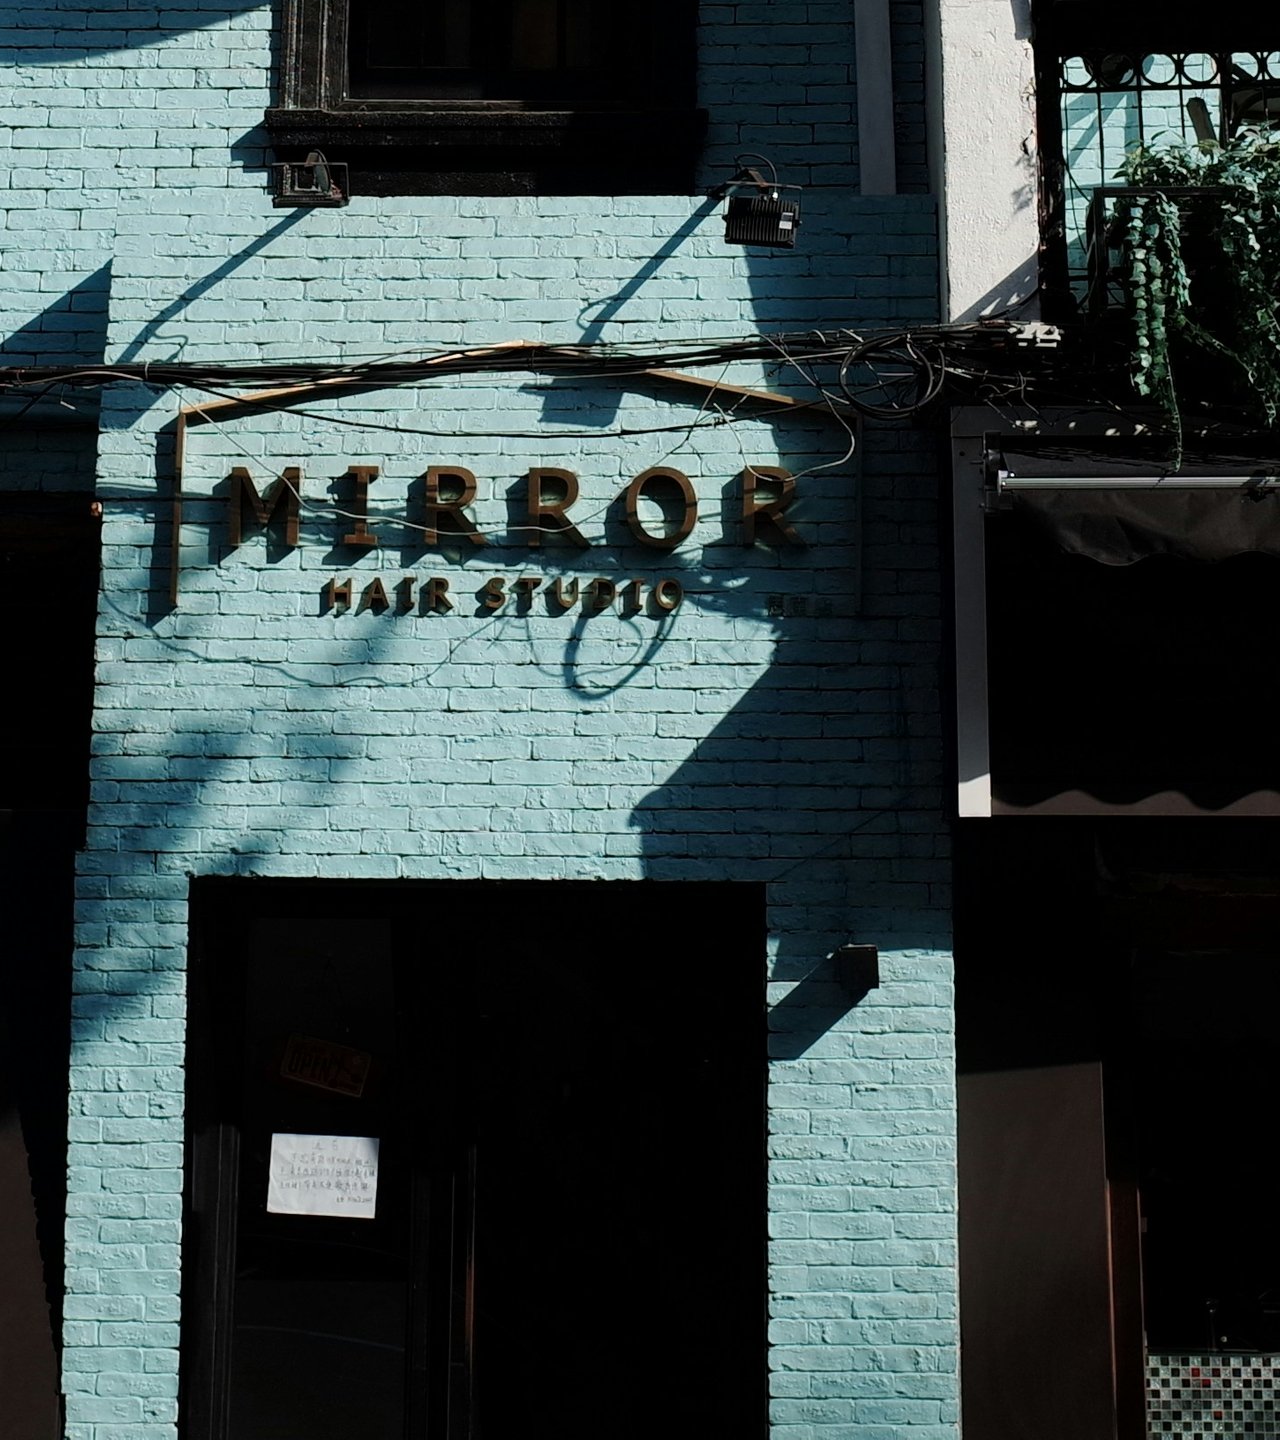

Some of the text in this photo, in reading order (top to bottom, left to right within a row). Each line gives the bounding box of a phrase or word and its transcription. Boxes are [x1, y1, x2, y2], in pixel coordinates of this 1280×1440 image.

[229, 465, 806, 549] MIRROR
[328, 577, 684, 611] HAIR STUDIO
